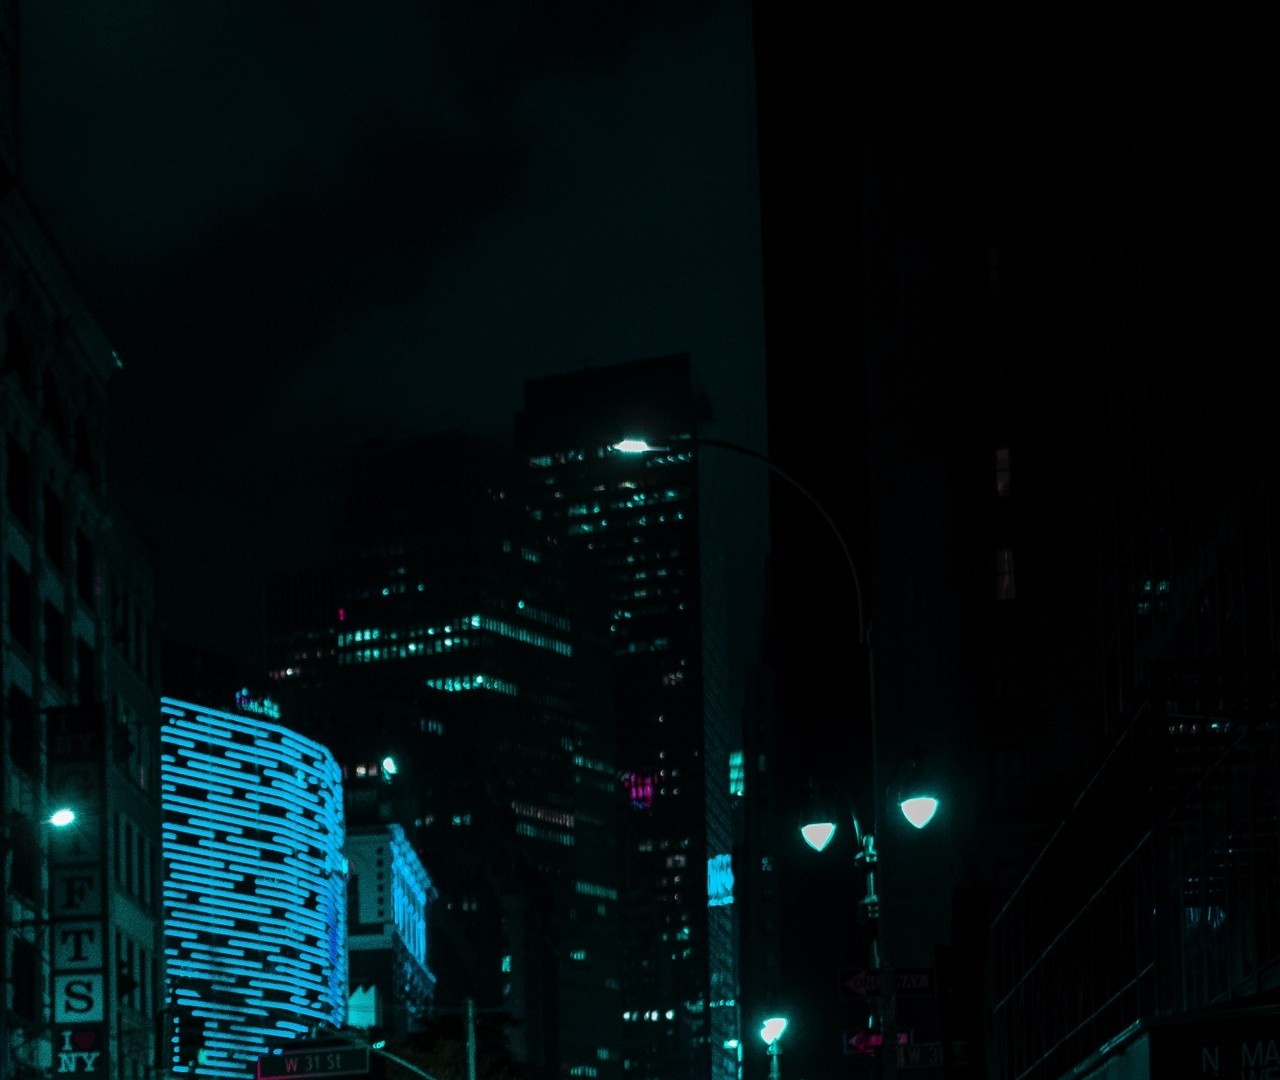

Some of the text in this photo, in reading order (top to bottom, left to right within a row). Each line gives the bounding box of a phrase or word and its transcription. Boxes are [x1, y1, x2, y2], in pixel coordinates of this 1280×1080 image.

[58, 1052, 101, 1073] NY
[285, 1056, 299, 1073] W
[305, 1053, 320, 1072] 31
